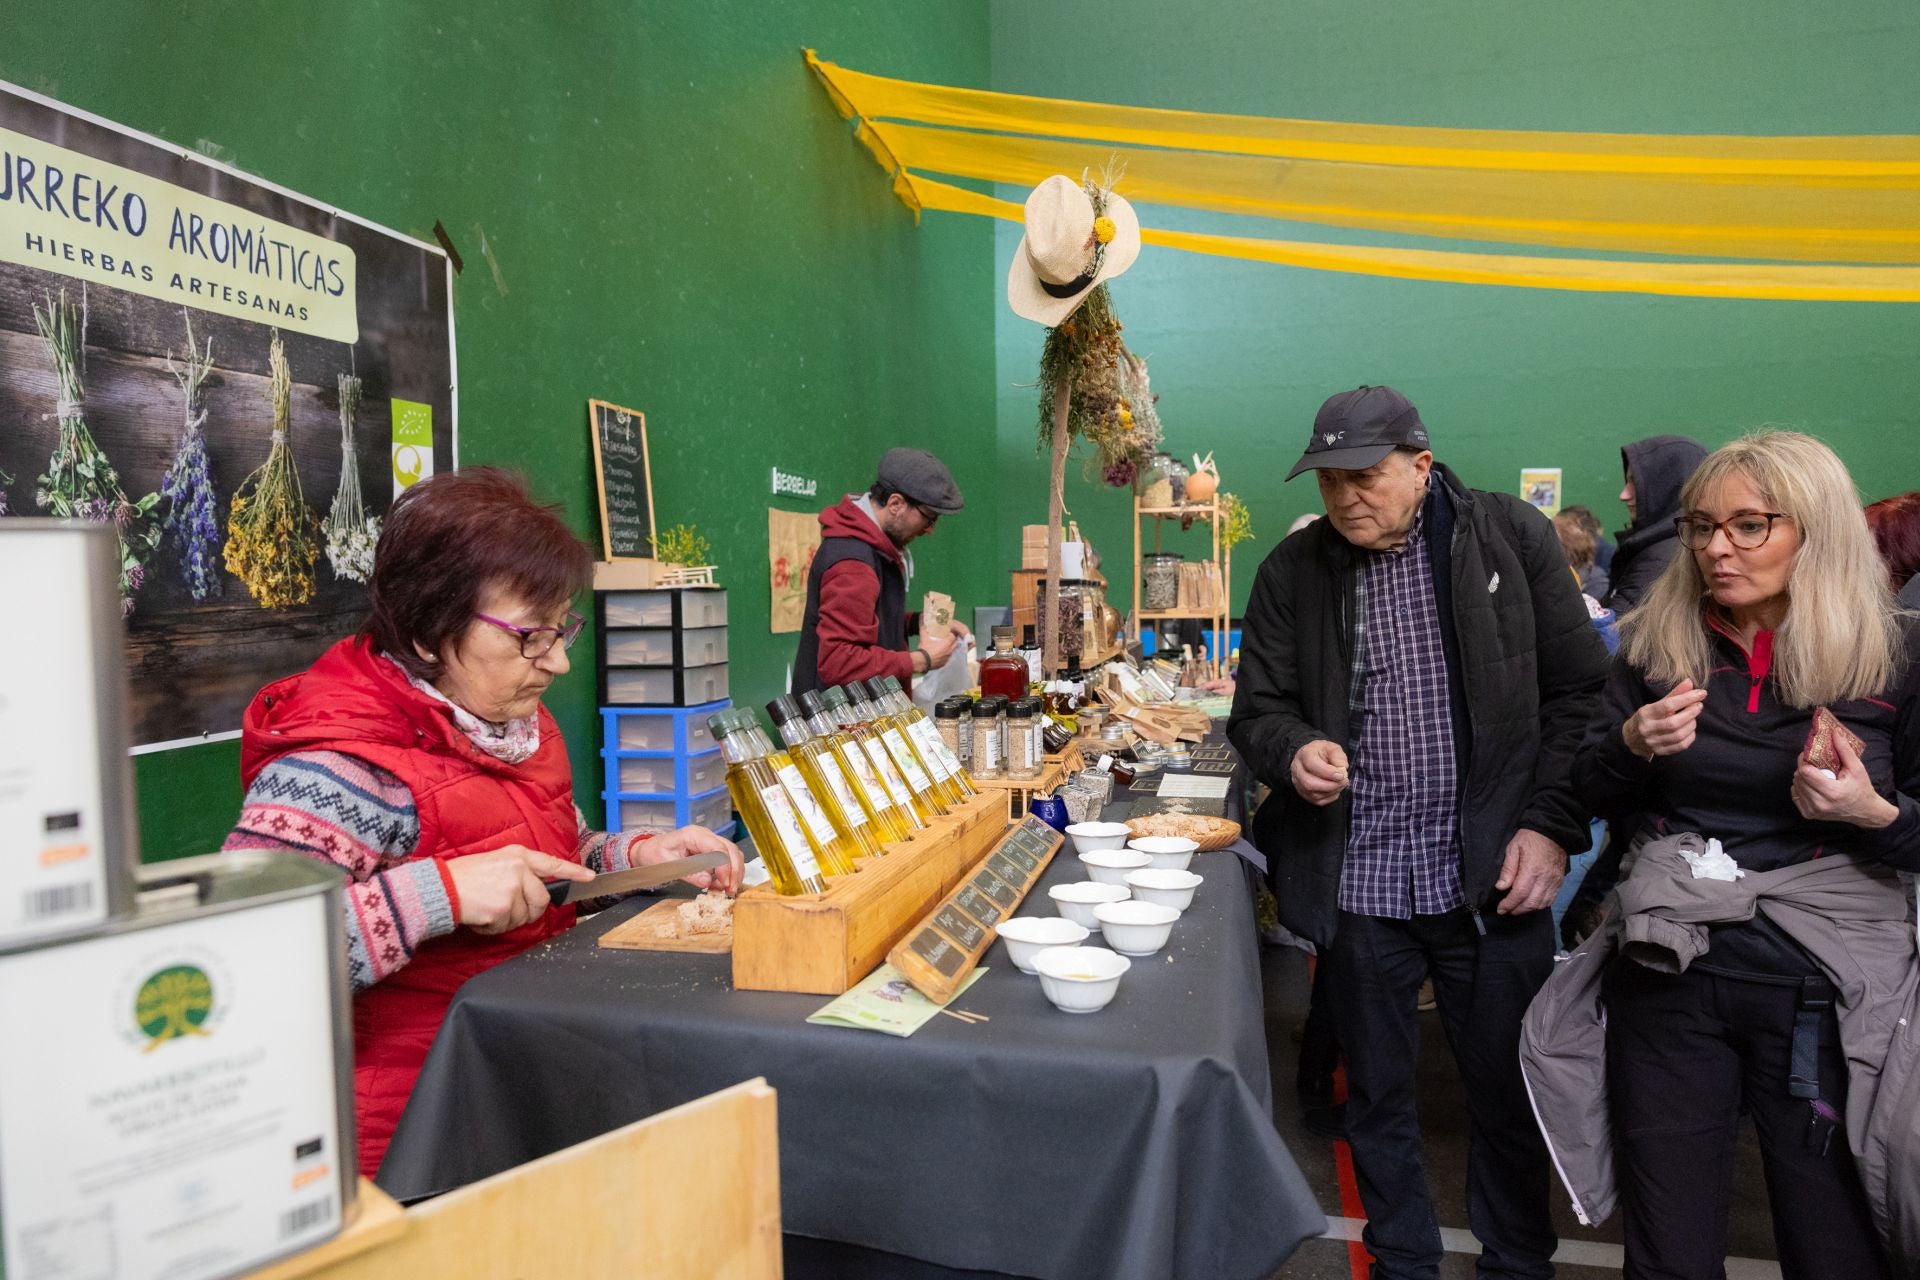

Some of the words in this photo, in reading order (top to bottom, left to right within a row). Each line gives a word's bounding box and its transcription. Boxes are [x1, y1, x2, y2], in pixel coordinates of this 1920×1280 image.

[25, 232, 154, 282] HIERBAS
[170, 273, 309, 321] ARTESANAS
[169, 206, 345, 297] AROMÁTICAS
